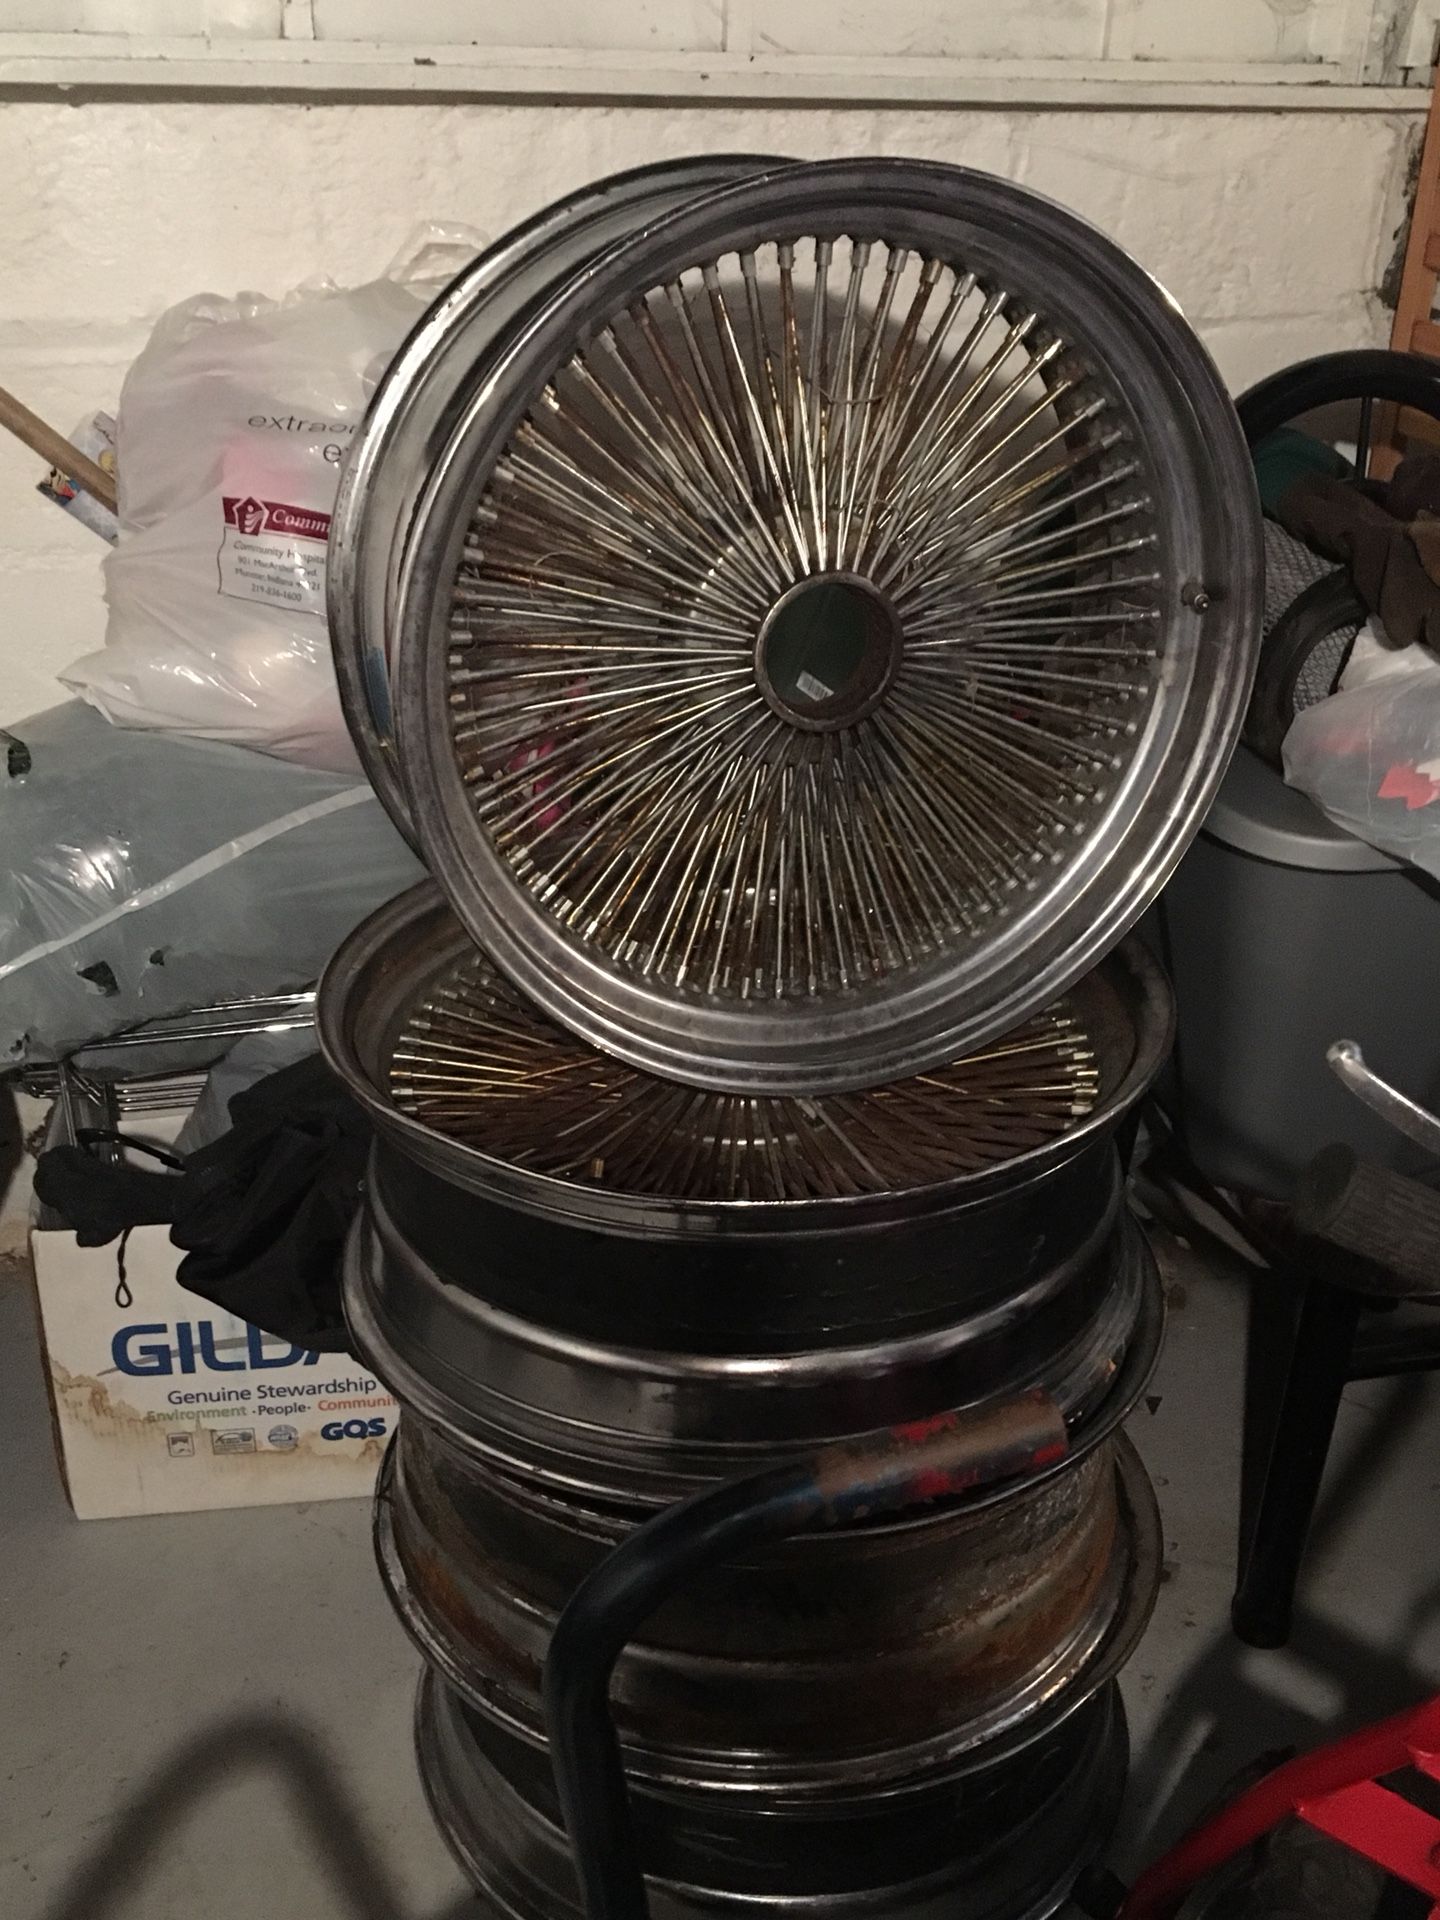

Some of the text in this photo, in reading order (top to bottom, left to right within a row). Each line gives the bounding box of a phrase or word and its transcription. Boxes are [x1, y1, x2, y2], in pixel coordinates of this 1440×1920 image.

[233, 540, 325, 565] Community Hspita
[111, 1320, 321, 1377] GILD
[167, 1377, 377, 1405] Genuine Stewardship
[147, 1405, 247, 1424] Environment
[321, 1417, 387, 1441] GQS
